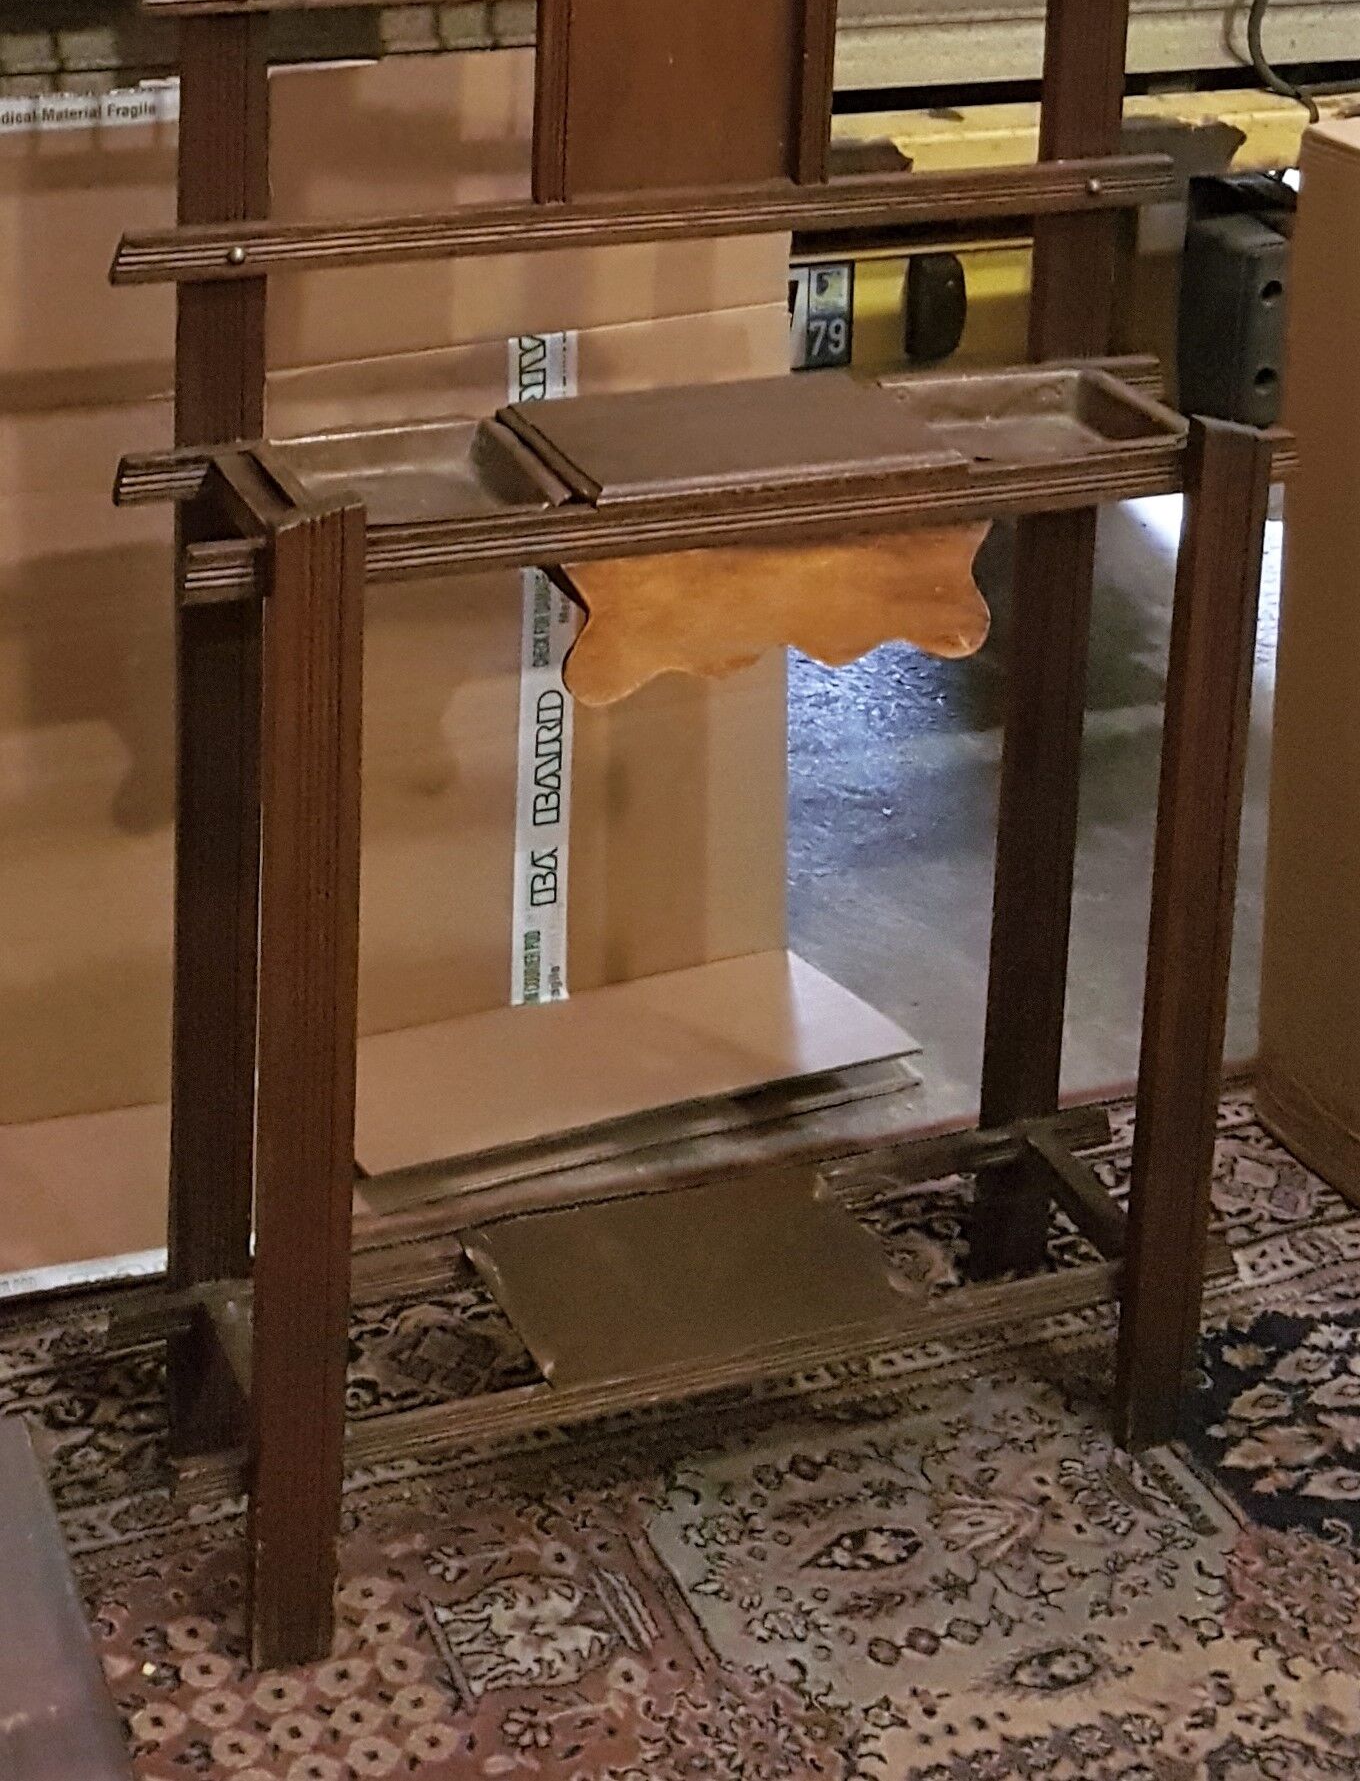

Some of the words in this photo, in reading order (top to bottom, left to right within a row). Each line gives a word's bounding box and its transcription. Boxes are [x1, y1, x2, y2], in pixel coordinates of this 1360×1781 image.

[42, 107, 101, 122] Material
[107, 102, 157, 118] Fragile
[809, 318, 847, 356] 79
[533, 689, 564, 826] BARD
